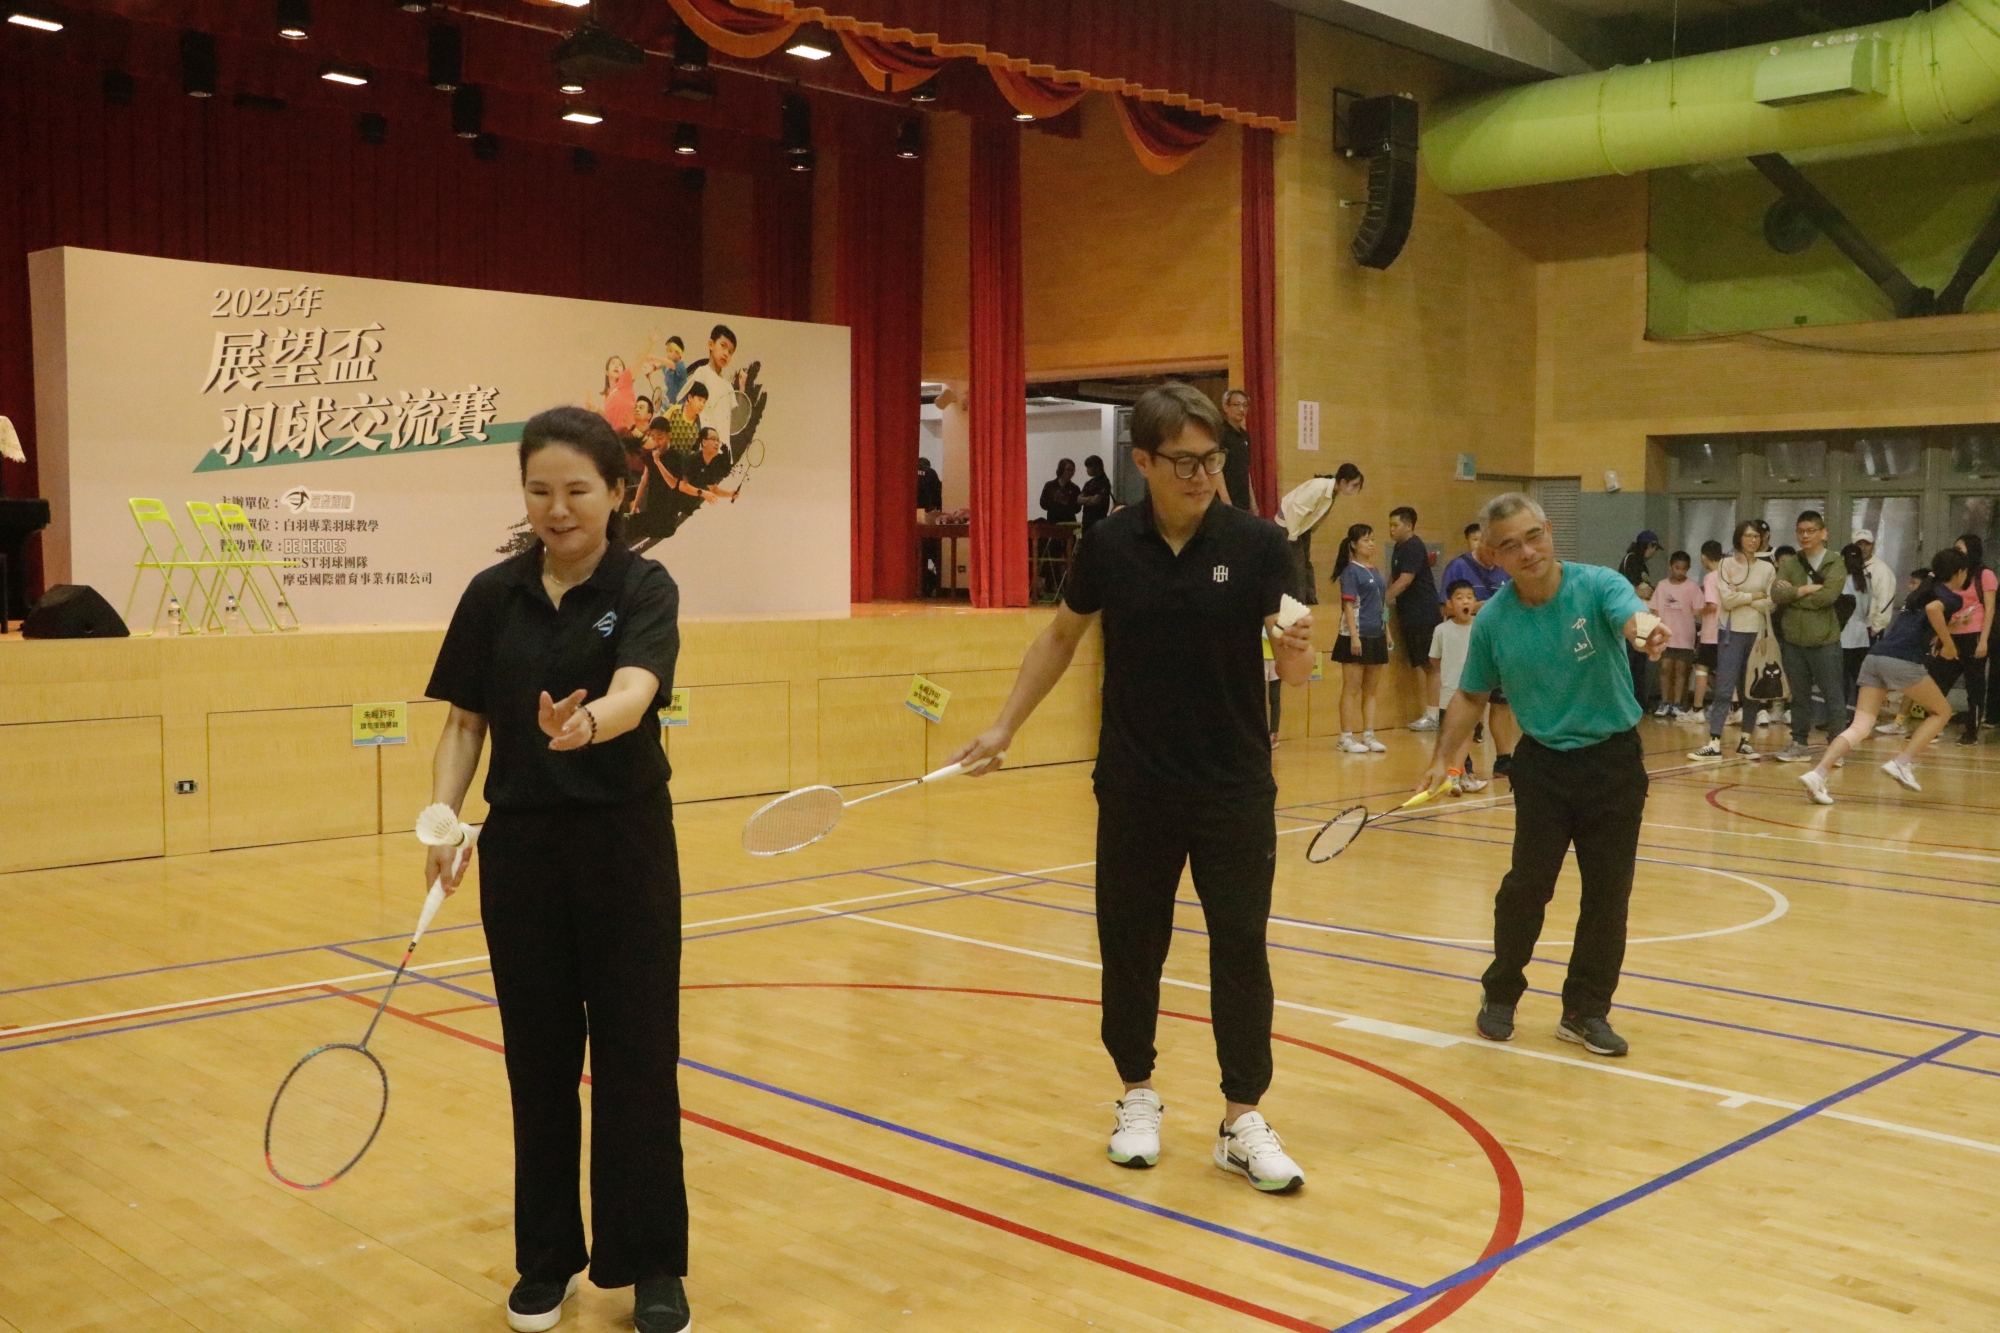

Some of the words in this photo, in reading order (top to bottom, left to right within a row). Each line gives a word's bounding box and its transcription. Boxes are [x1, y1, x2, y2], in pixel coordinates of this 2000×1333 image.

[210, 283, 324, 318] 2025年
[200, 321, 385, 394] 展望盃
[214, 384, 499, 466] 羽球交流賽
[284, 518, 379, 532] 白羽專業羽球教學
[283, 538, 300, 554] BE
[302, 538, 347, 554] HEROES
[283, 572, 432, 586] 摩亞國際體育事業有限公司
[364, 710, 396, 718] 未經許可
